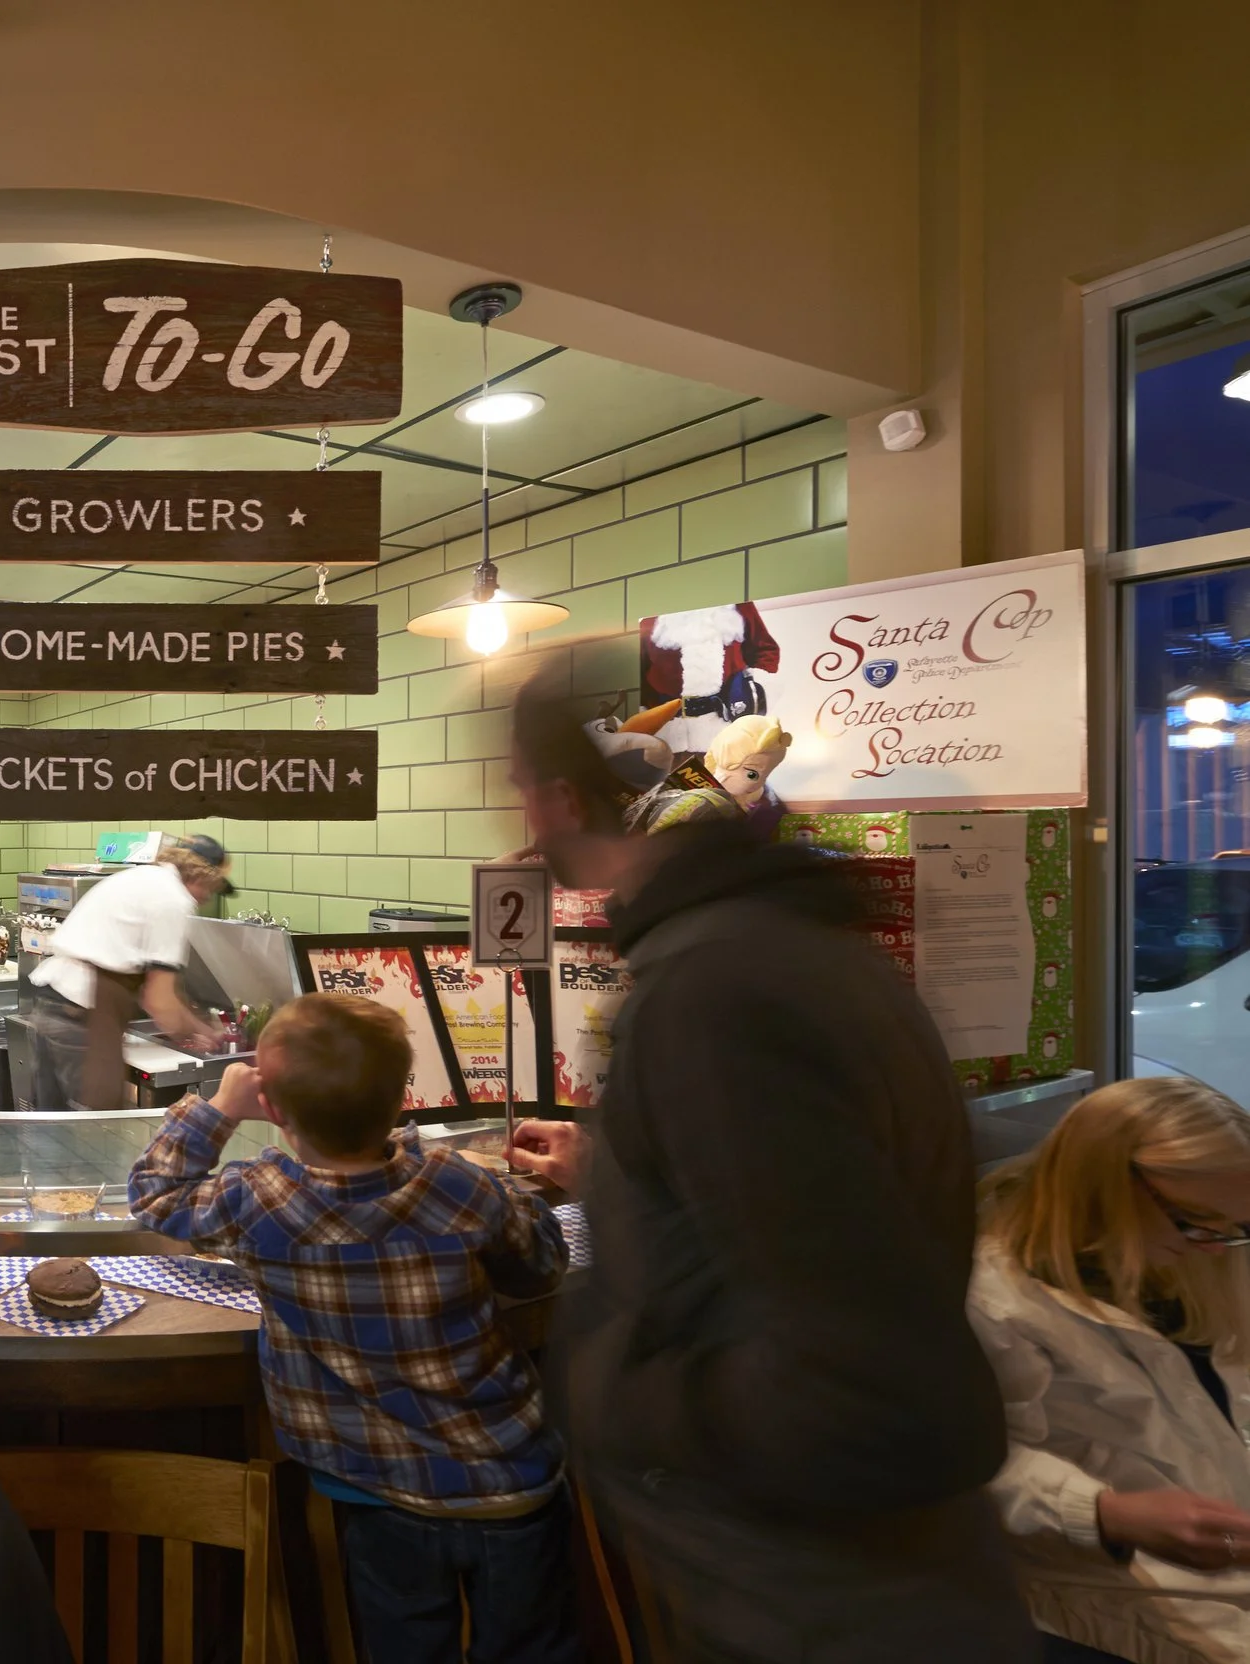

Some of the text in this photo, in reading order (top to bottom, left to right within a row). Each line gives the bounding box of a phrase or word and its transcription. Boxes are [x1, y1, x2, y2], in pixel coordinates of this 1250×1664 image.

[102, 296, 350, 391] To-Go
[12, 496, 264, 534] GROWLERS
[227, 631, 305, 662] PIES
[812, 588, 1053, 682] Santa Cop
[903, 655, 959, 672] Lafayette
[911, 669, 945, 684] Police
[814, 688, 977, 738] Collection
[851, 726, 1004, 779] Location
[125, 763, 158, 791] of
[169, 758, 335, 793] CHICKEN
[677, 766, 713, 789] NER
[500, 890, 524, 940] 2
[560, 982, 624, 992] BOULDER
[471, 1056, 498, 1065] 2014
